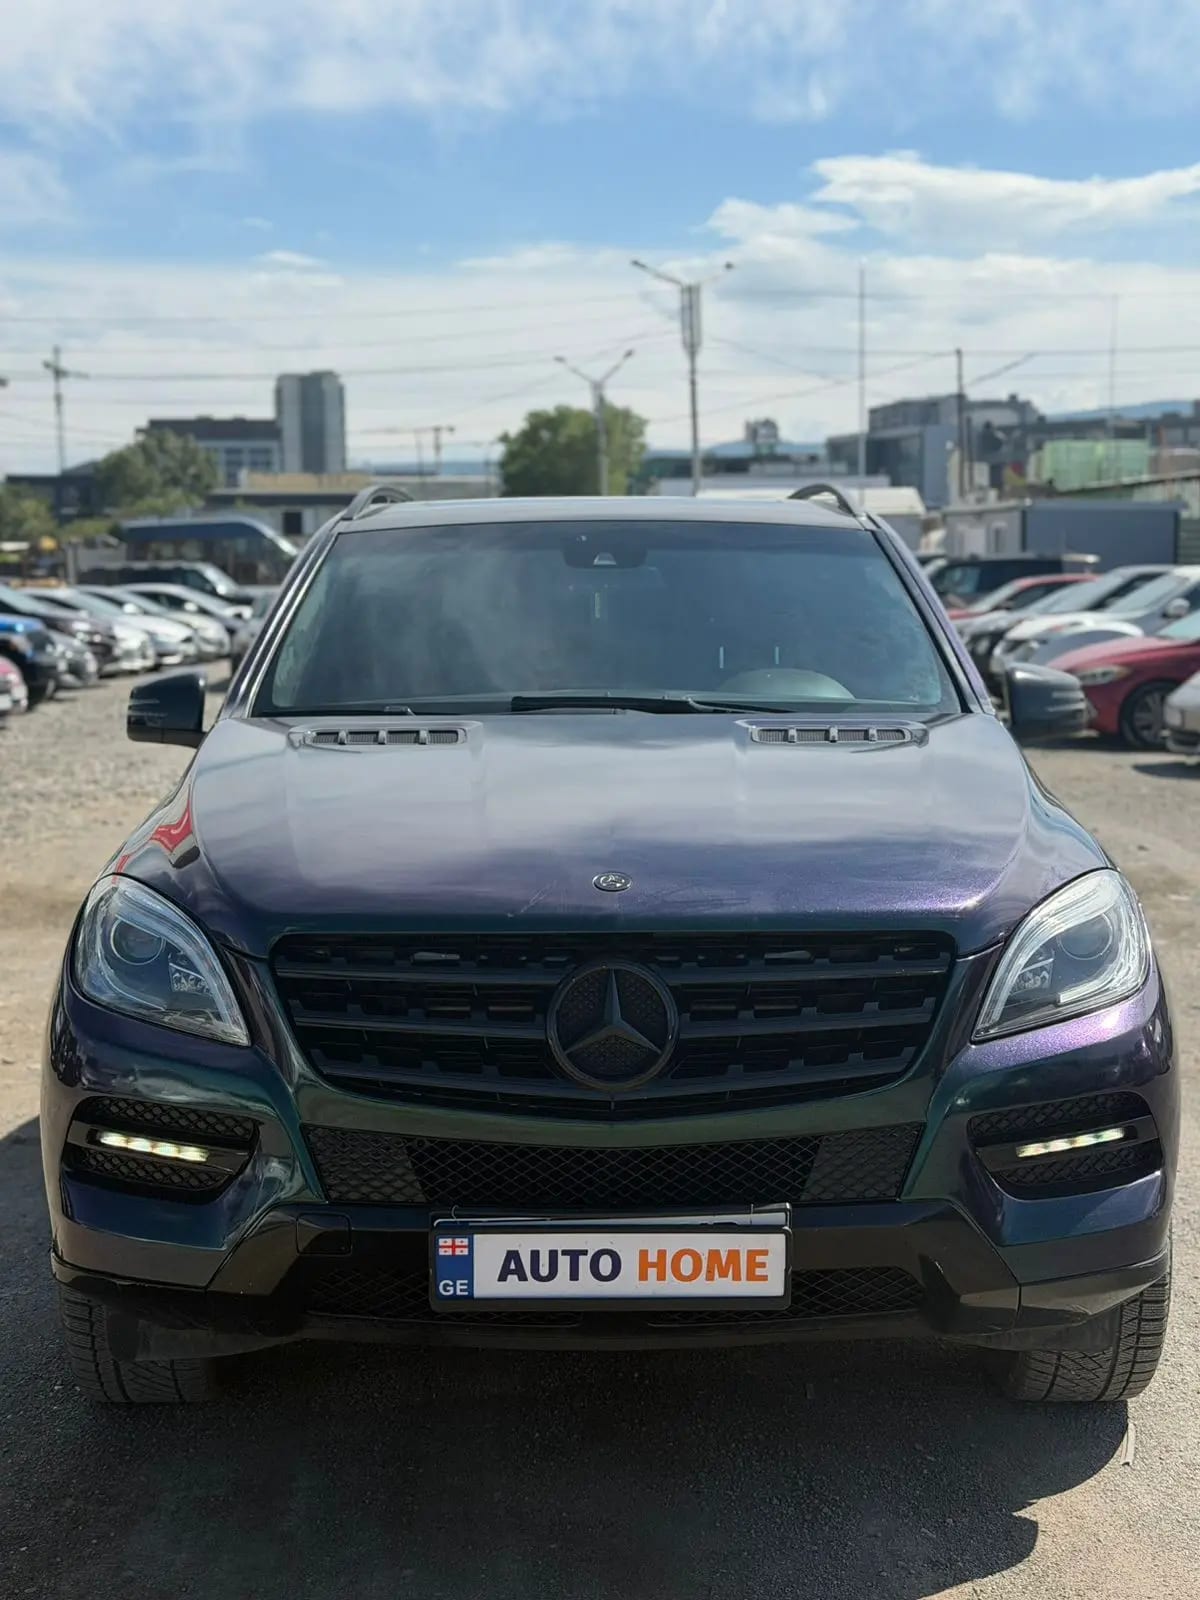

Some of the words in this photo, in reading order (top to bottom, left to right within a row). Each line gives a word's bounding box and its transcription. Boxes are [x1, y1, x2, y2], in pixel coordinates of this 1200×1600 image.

[497, 1248, 622, 1282] AUTO
[638, 1248, 769, 1282] HOME
[439, 1280, 468, 1295] GE
